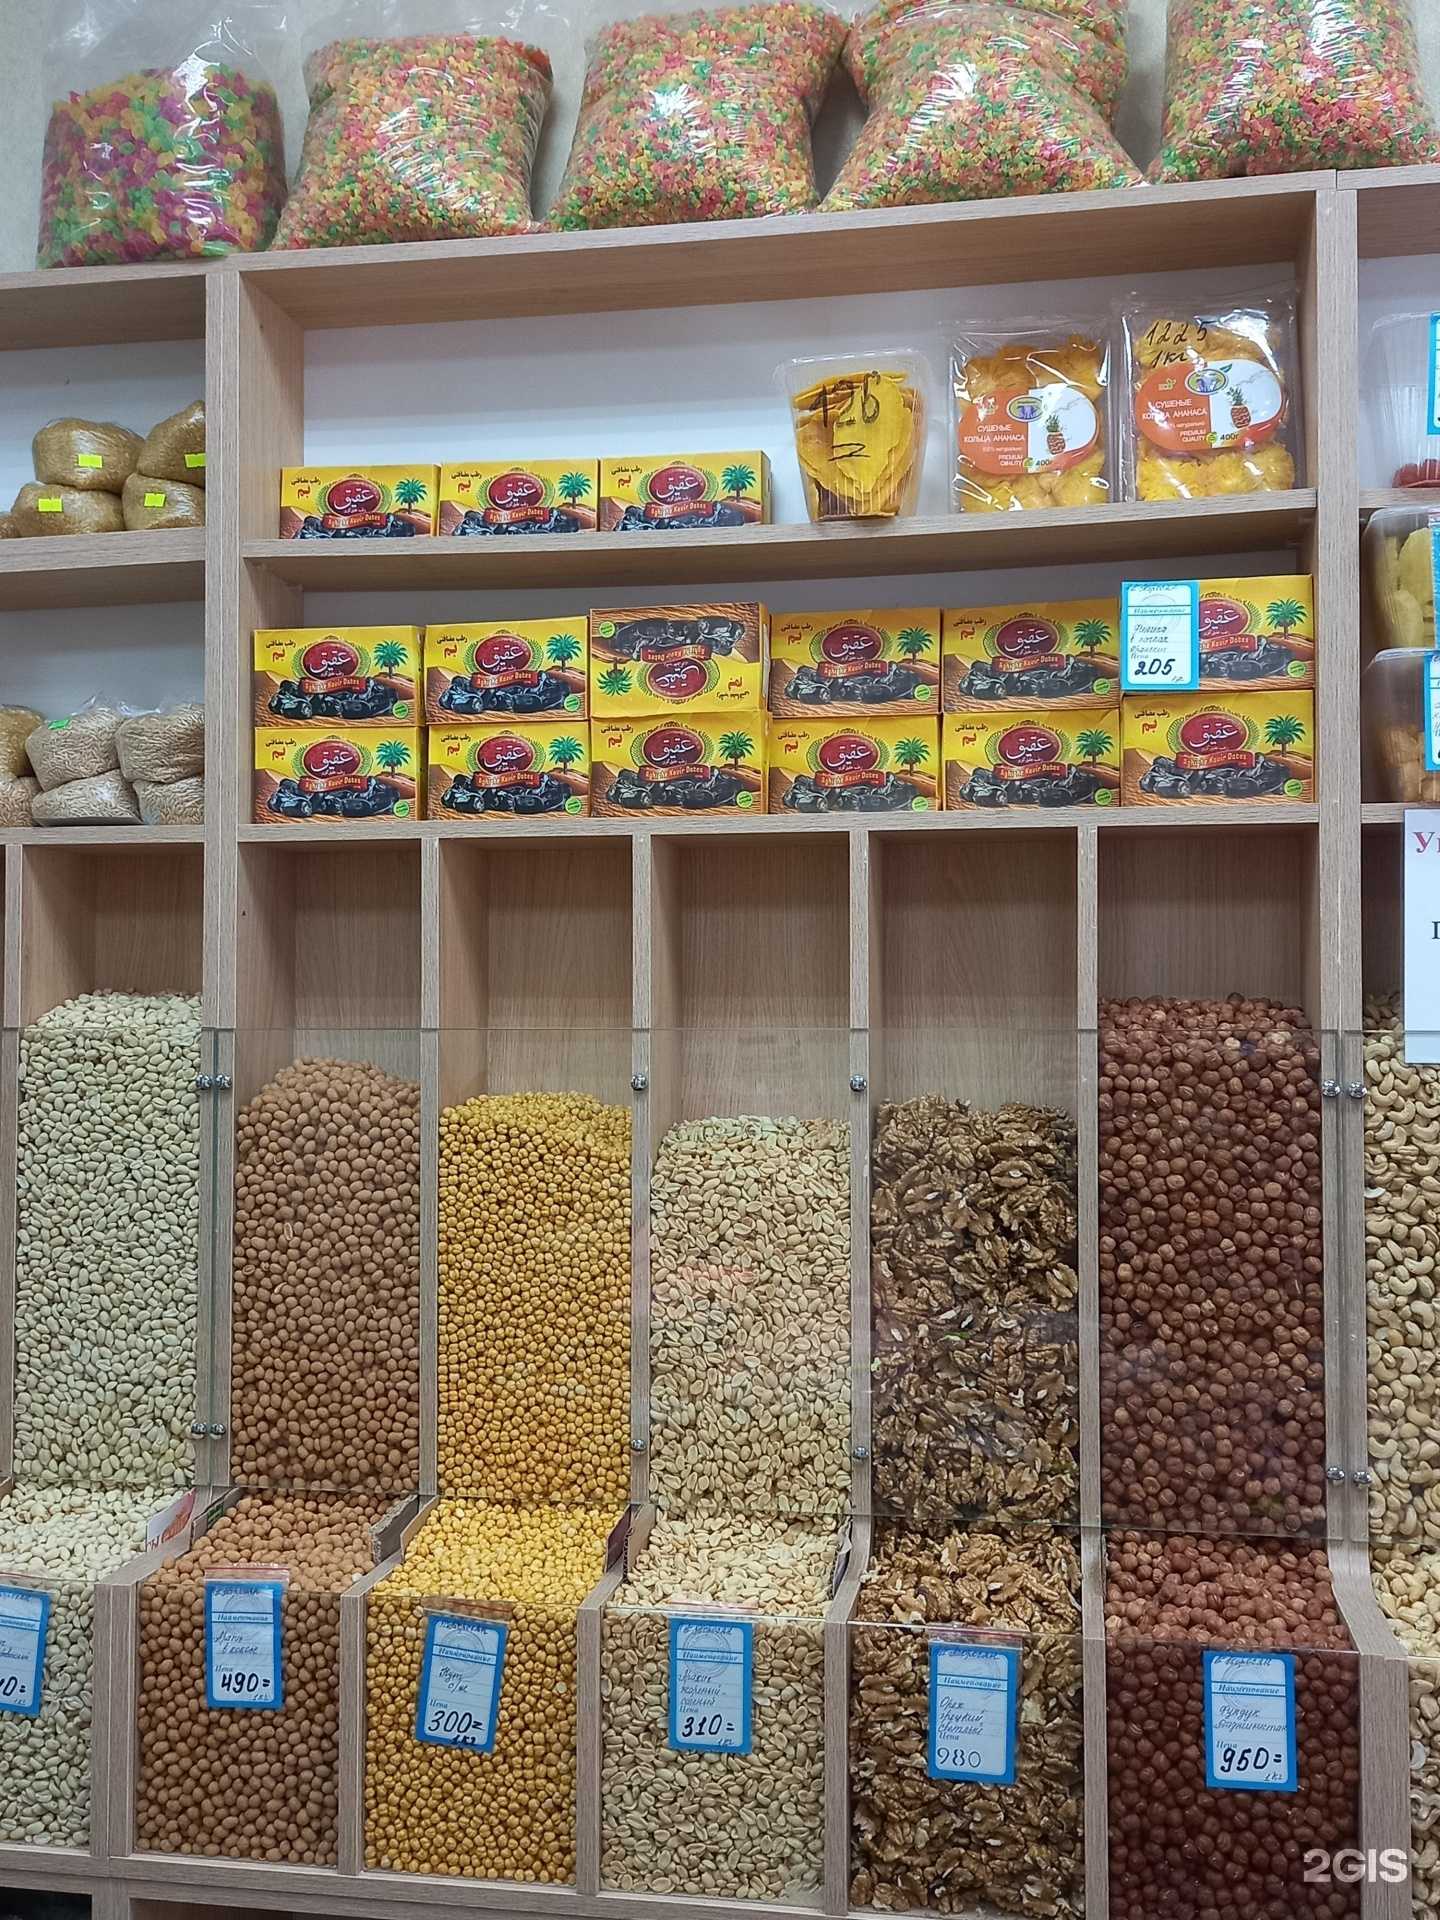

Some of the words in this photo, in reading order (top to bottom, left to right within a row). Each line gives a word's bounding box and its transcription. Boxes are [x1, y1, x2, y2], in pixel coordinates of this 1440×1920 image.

[1147, 321, 1207, 345] 1225
[1173, 408, 1207, 418] АНАНАСА
[1134, 658, 1176, 675] 205
[937, 1747, 982, 1768] 980
